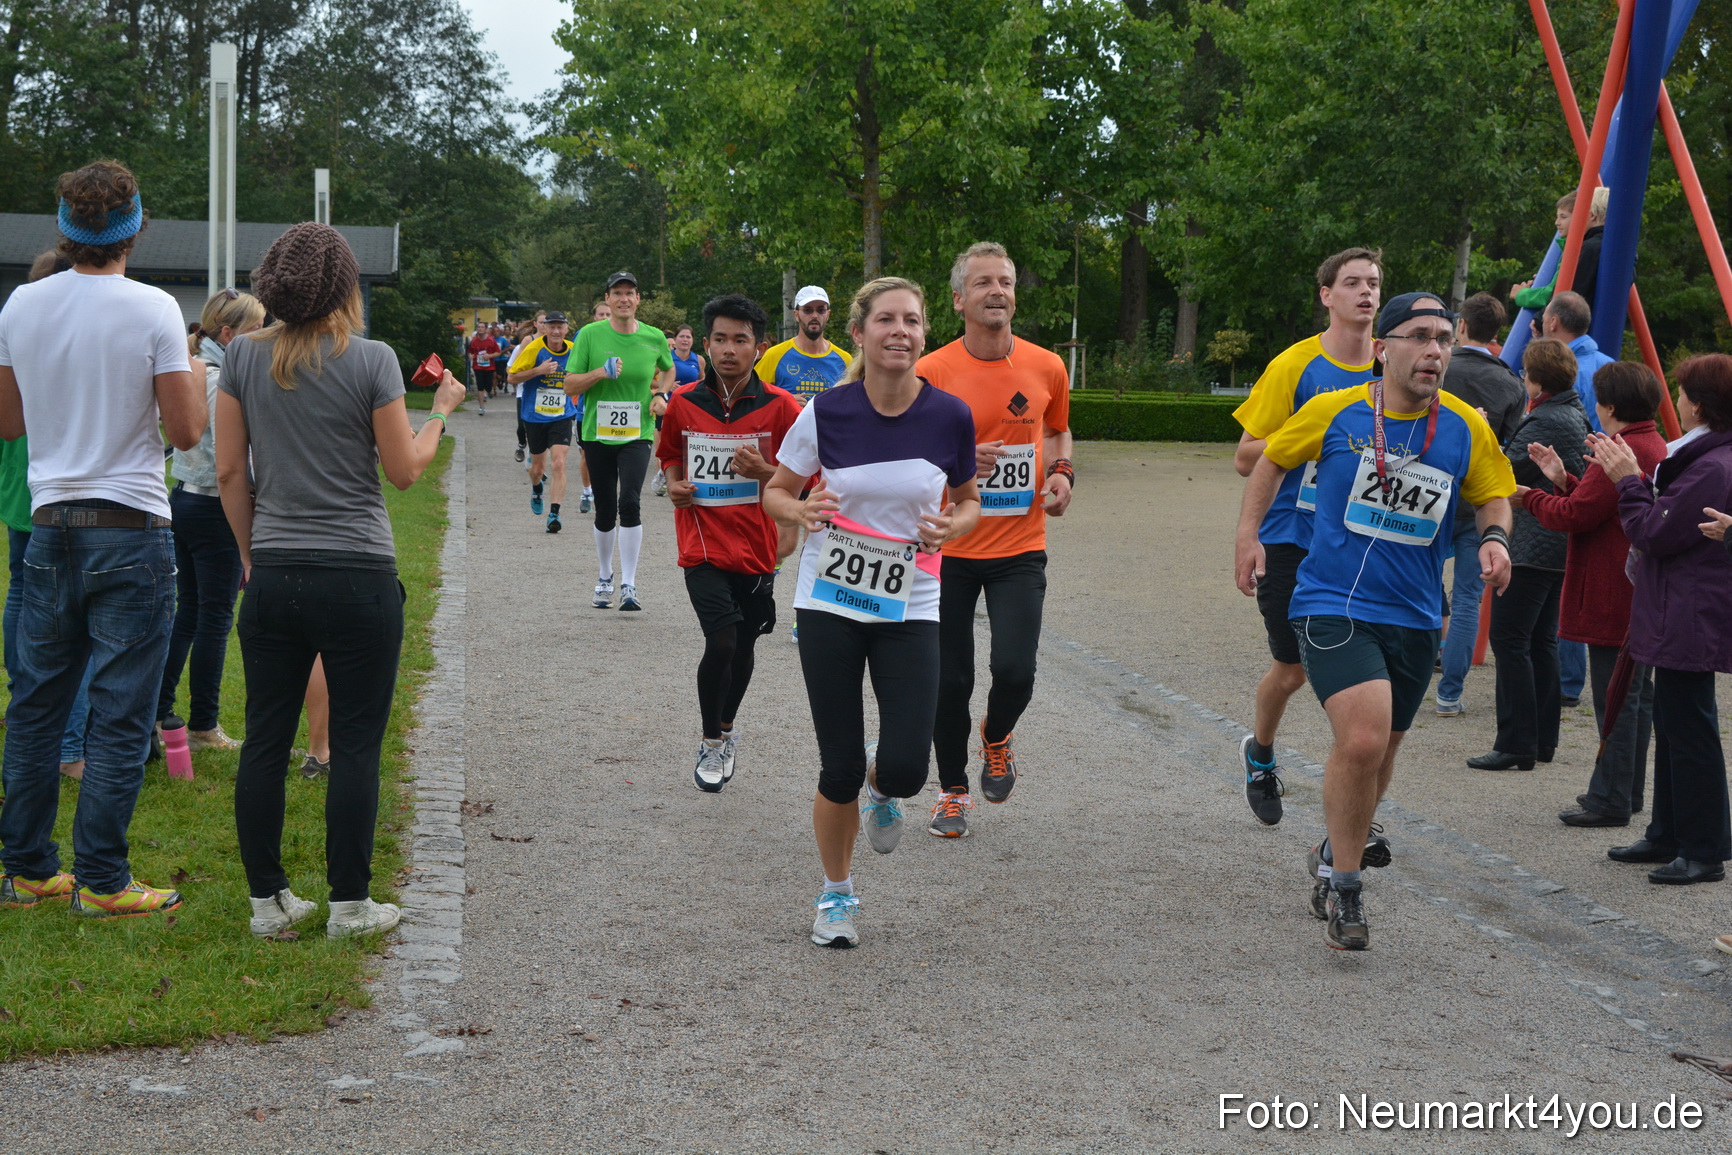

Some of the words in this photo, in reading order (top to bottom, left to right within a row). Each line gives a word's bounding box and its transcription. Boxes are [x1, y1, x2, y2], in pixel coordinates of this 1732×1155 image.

[541, 394, 560, 406] 284
[610, 411, 628, 426] 28
[1375, 416, 1383, 447] BAYERN
[689, 443, 709, 453] PARTL
[710, 445, 737, 453] Neuma
[1376, 449, 1383, 460] FC
[693, 454, 740, 480] 244
[977, 461, 1030, 489] 289
[708, 486, 734, 497] Diem
[980, 494, 1019, 507] Michael
[1360, 471, 1442, 515] 2847
[51, 510, 97, 527] PMA
[1370, 511, 1417, 534] Thomas
[827, 531, 855, 548] PARTL
[856, 541, 901, 559] Neumarkt
[824, 547, 905, 594] 2918
[835, 589, 881, 613] Claudia
